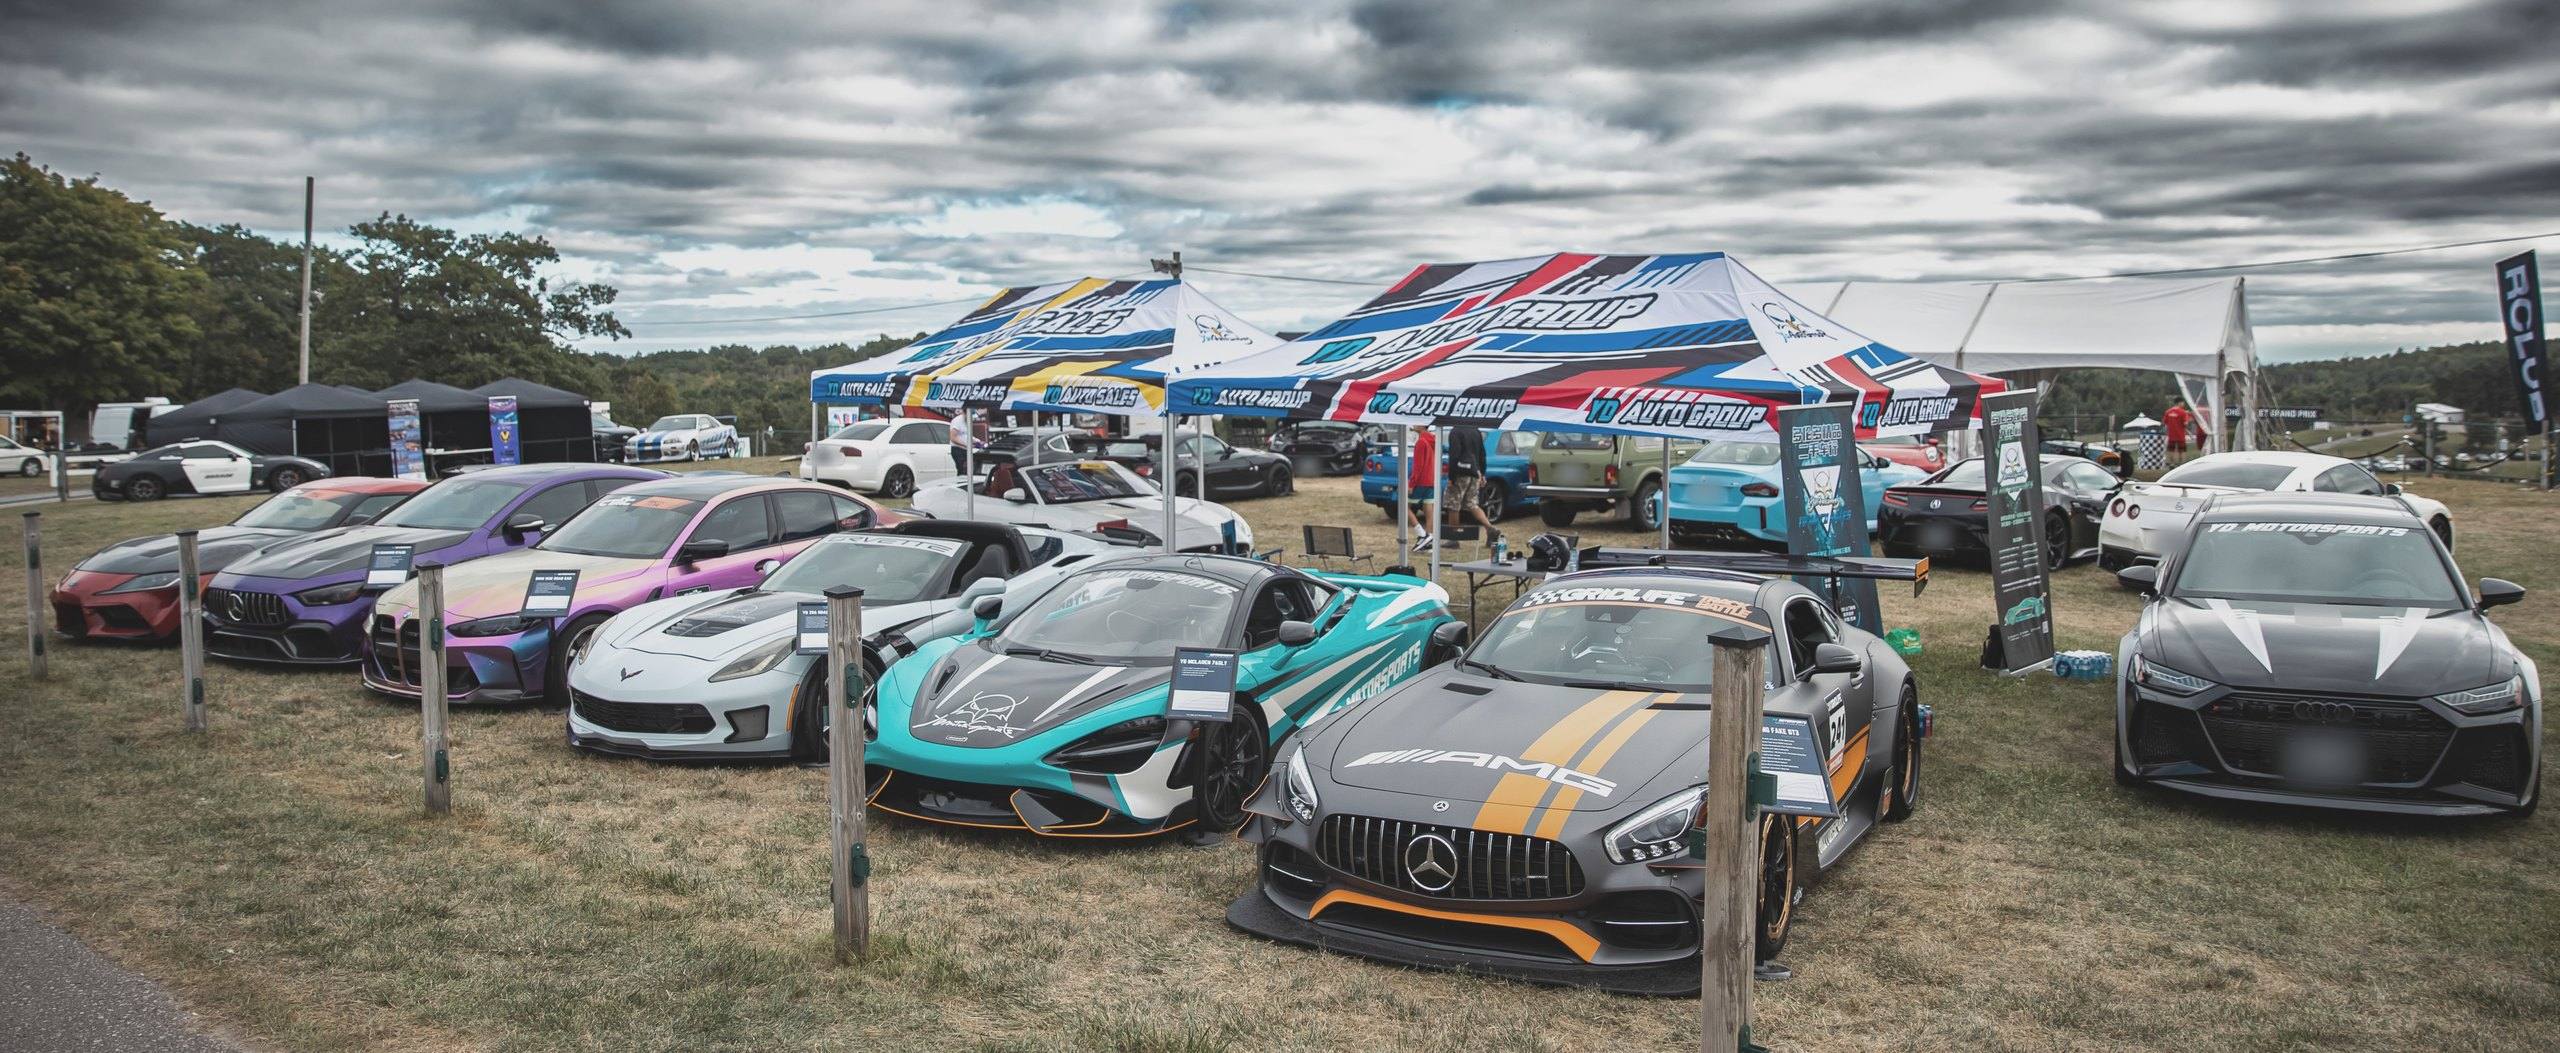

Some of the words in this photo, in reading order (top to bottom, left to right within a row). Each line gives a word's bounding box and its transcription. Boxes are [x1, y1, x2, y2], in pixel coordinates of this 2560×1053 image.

[1297, 336, 1377, 365] YD
[1361, 311, 1490, 358] AUTO
[1476, 292, 1658, 334] GROUP
[839, 381, 864, 398] AUTO
[863, 381, 896, 398] SALES
[926, 383, 943, 401] YD
[939, 385, 973, 402] AUTO
[970, 384, 1007, 402] SALES
[1042, 384, 1061, 404] YD
[1059, 386, 1097, 406] AUTO
[1094, 386, 1140, 407] SALES
[1190, 386, 1213, 405] YD
[1214, 389, 1258, 407] AUTO
[1256, 389, 1312, 409] GROUP
[1368, 391, 1398, 414] YD
[1399, 394, 1452, 417] AUTO
[1449, 396, 1518, 420] GROUP
[1586, 398, 1620, 424] YD
[1619, 400, 1687, 427] AUTO
[1684, 402, 1767, 432] GROUP
[1860, 402, 1881, 428] YD
[1880, 399, 1921, 428] AUTO
[1918, 396, 1958, 424] GROUP
[2224, 407, 2269, 417] CHEET
[2297, 409, 2317, 418] PRIX
[2241, 523, 2409, 536] MOTORSPORTS
[1558, 587, 1697, 606] GRIDLIFE
[1694, 601, 1752, 619] BATTLE
[1770, 727, 1788, 735] FAKE
